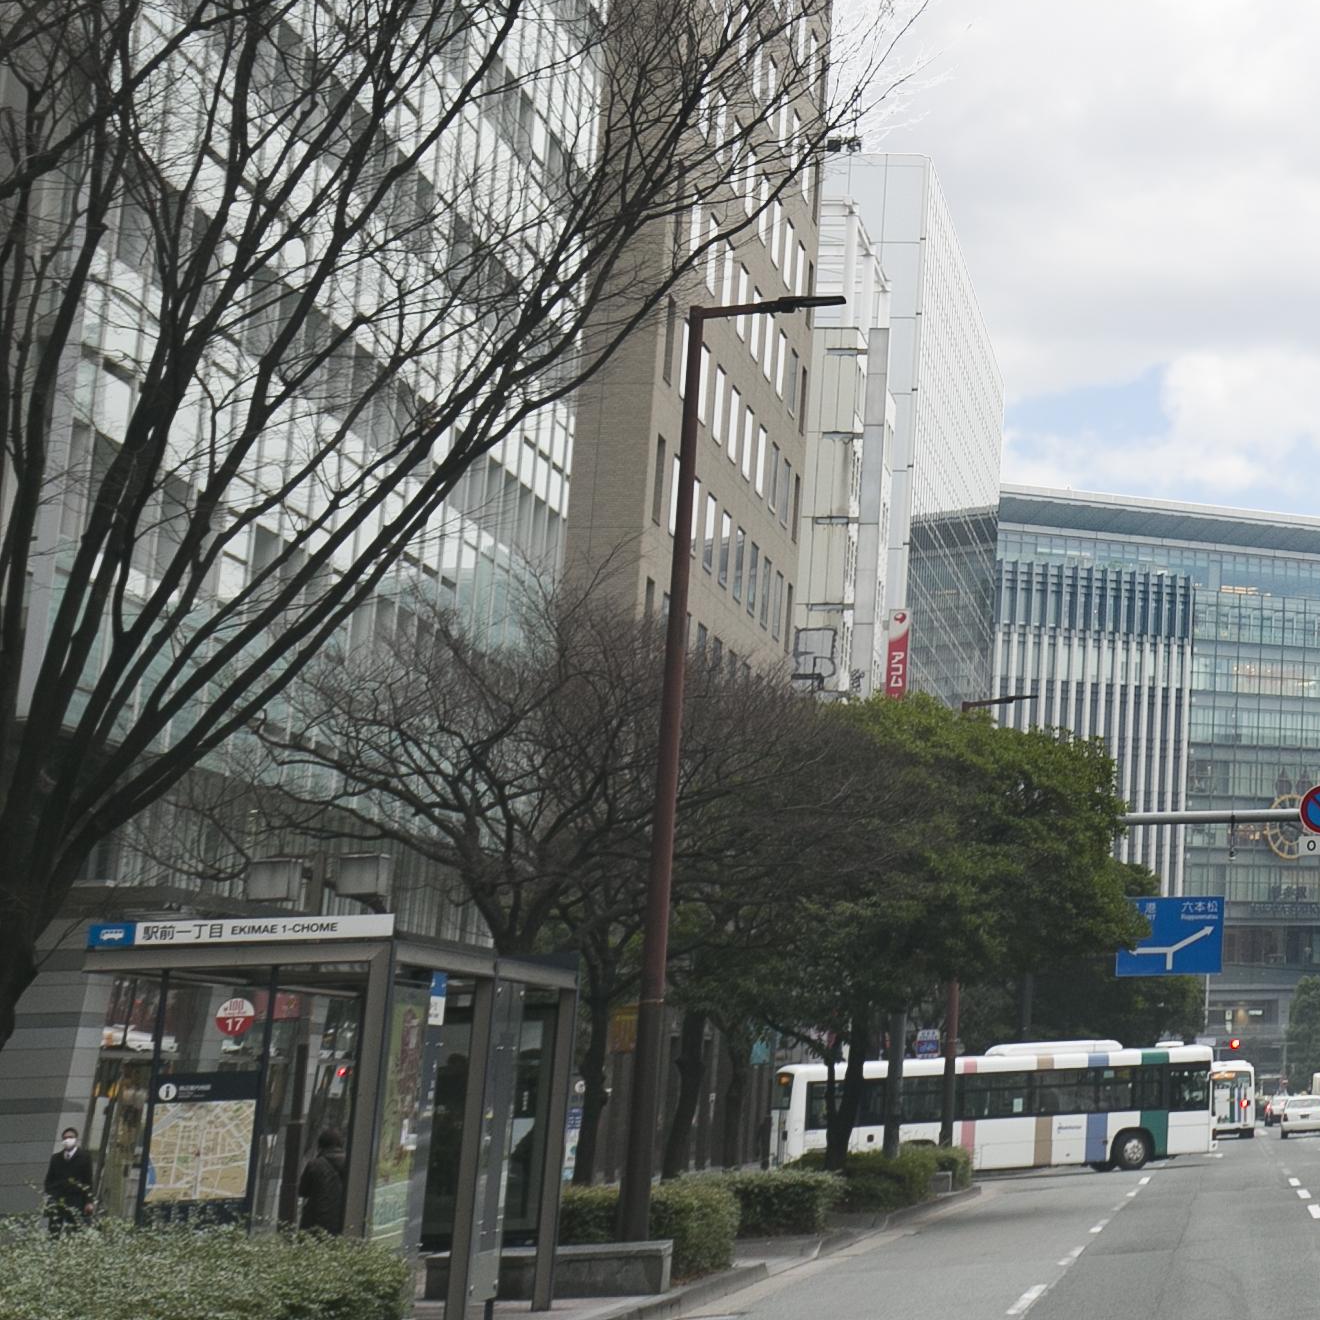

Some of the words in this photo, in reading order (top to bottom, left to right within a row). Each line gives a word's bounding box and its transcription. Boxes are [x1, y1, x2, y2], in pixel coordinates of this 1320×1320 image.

[891, 651, 905, 687] アコム
[1181, 901, 1218, 913] 六本松
[141, 922, 224, 940] 駅前一丁目
[230, 924, 278, 935] EKIMAE
[281, 922, 338, 934] 1-CHOME
[225, 1017, 245, 1032] 17
